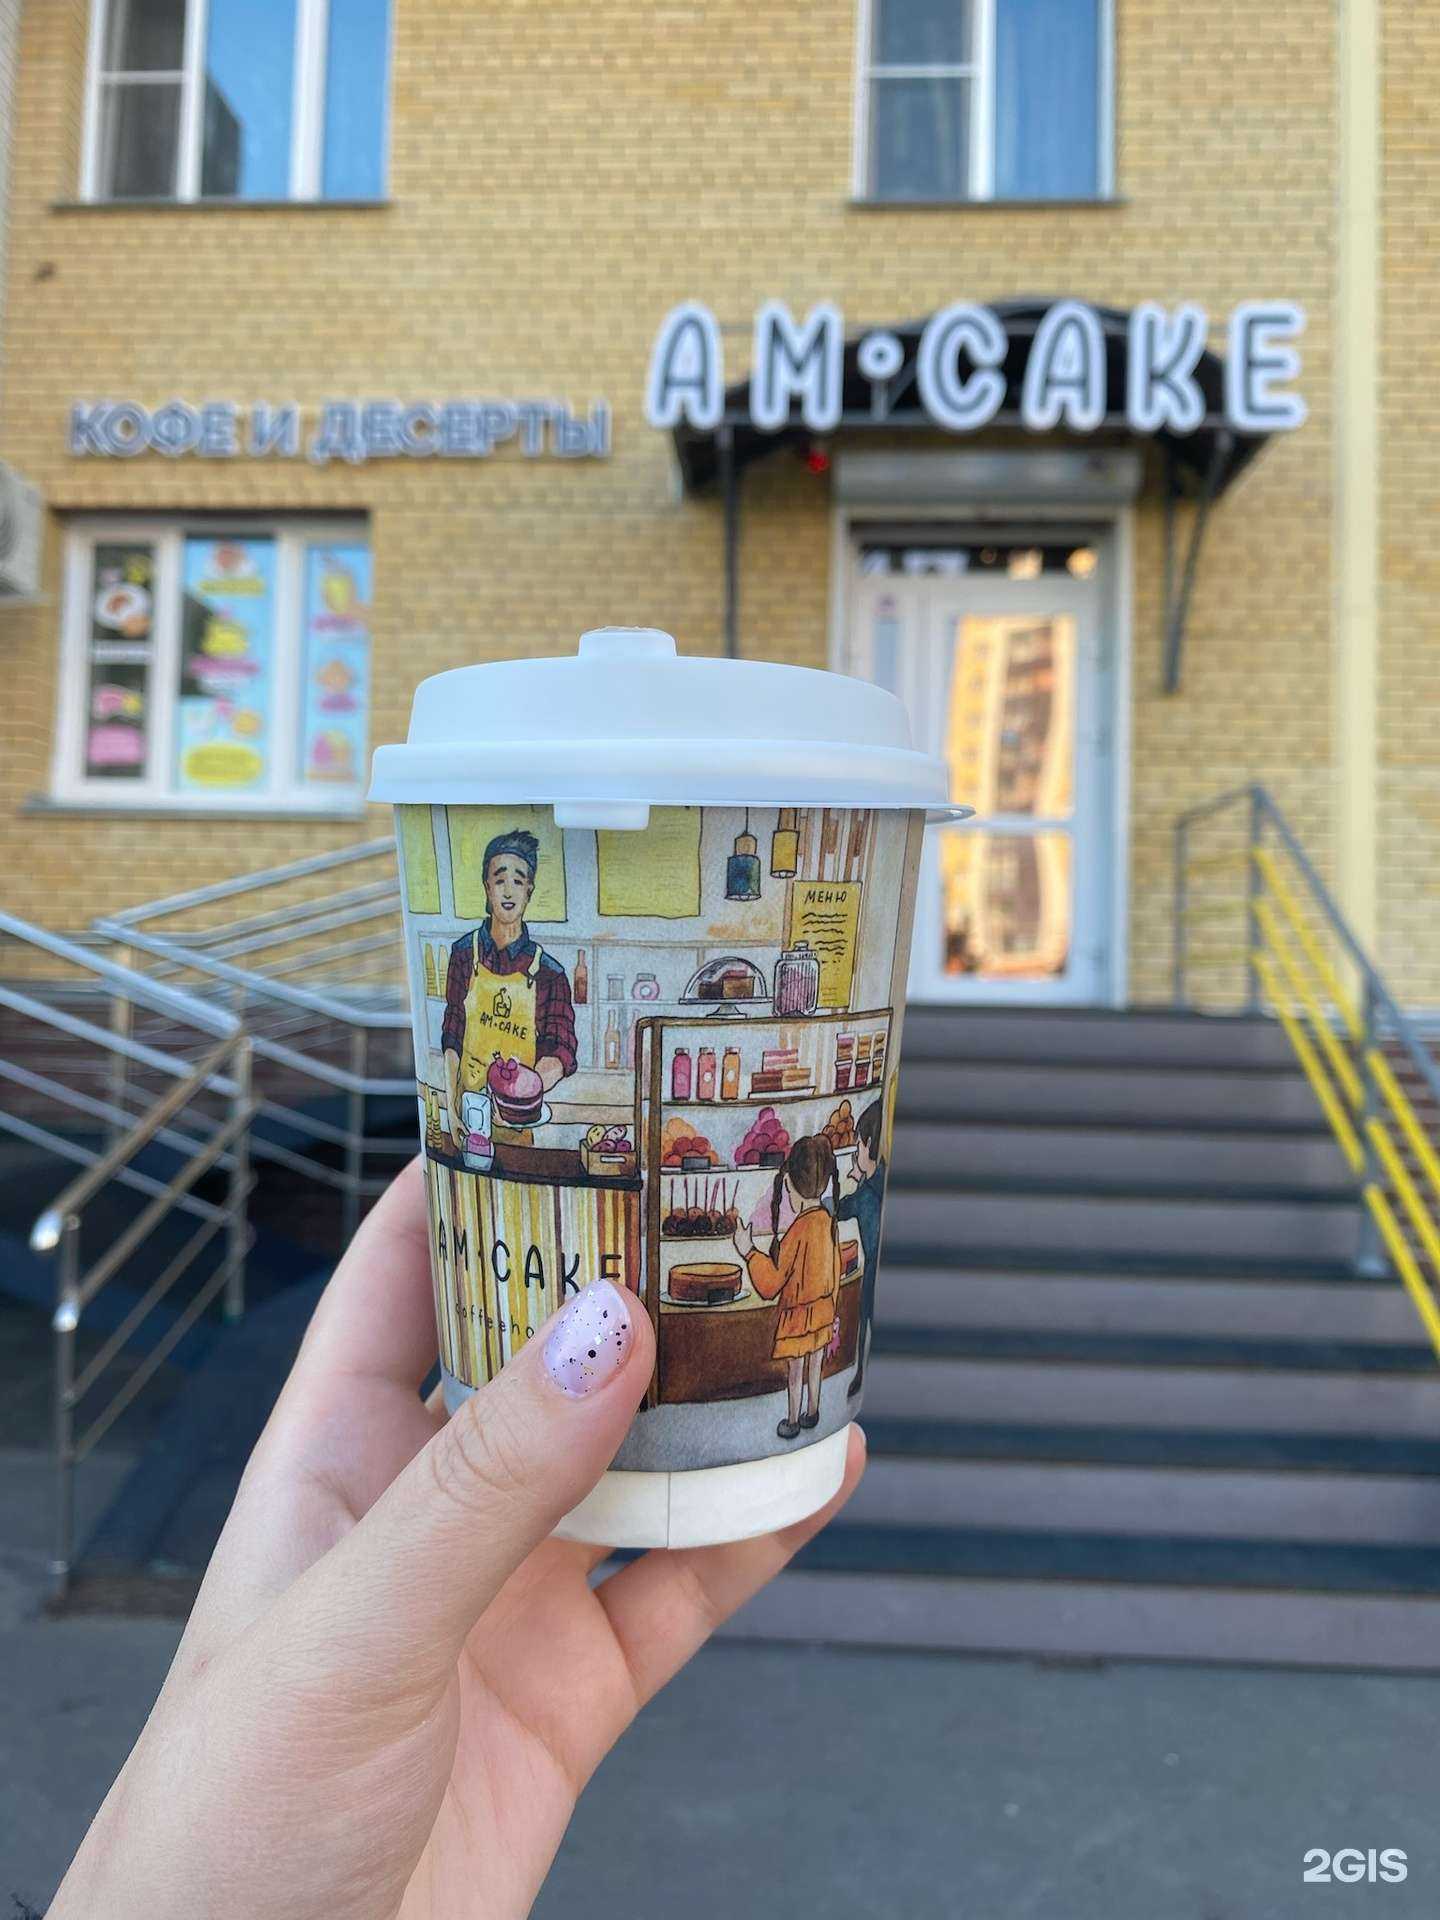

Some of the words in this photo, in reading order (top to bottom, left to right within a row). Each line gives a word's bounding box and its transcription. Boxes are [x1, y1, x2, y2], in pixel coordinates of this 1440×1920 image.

[68, 398, 238, 458] КОФЕ
[248, 398, 301, 458] И
[310, 398, 613, 465] ДЕСЕРТЫ
[804, 890, 848, 905] МЕНЮ
